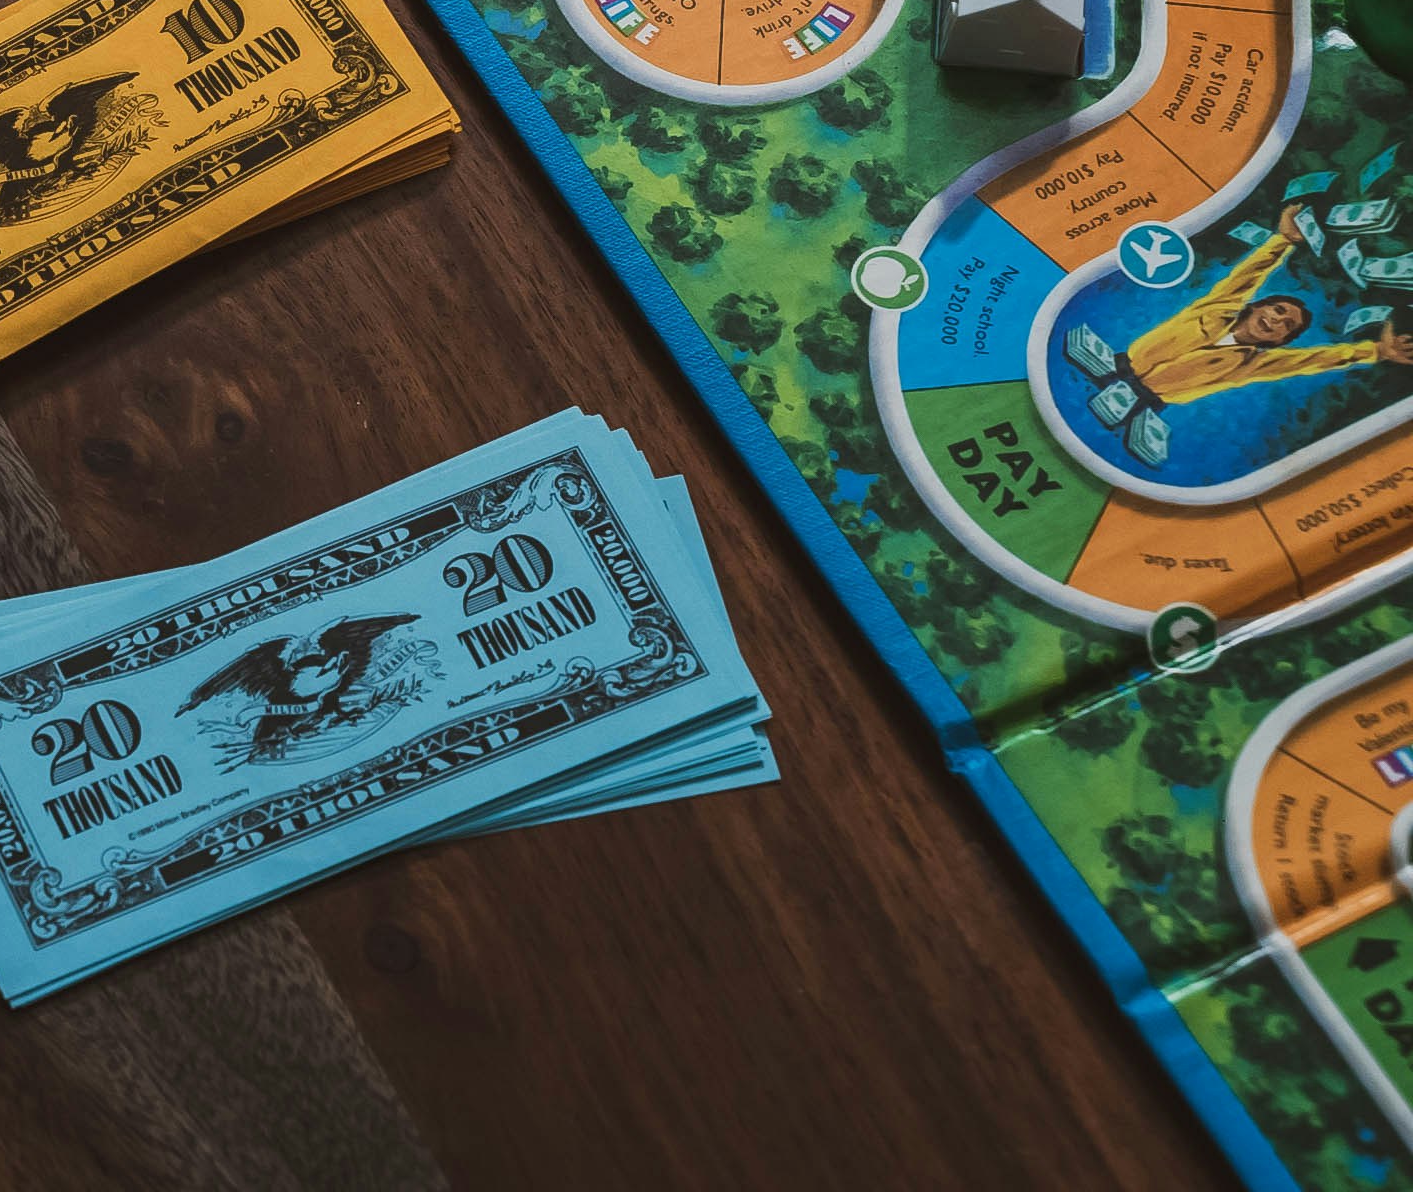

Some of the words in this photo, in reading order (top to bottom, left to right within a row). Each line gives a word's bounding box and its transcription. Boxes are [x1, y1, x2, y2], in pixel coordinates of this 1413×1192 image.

[753, 14, 793, 38] drink
[783, 6, 851, 60] LIFE
[174, 27, 301, 113] THOUSAND
[1188, 51, 1203, 69] not
[1209, 43, 1233, 67] Pay
[1246, 48, 1264, 75] Car
[107, 96, 141, 132] BRADLEY
[1159, 74, 1199, 122] insured.
[5, 168, 46, 180] MILTON
[1096, 149, 1125, 168] Pay
[1066, 180, 1127, 215] country.
[1115, 191, 1158, 216] Move
[21, 162, 242, 289] THOUSAND
[1065, 213, 1112, 240] across
[958, 256, 987, 281] Pay
[989, 264, 1021, 304] Night
[947, 437, 1030, 518] DAY
[983, 421, 1063, 498] PAY
[106, 626, 160, 657] 20
[165, 527, 410, 630] THOUSAND
[443, 534, 553, 617] 20
[457, 586, 596, 669] THOUSAND
[379, 642, 418, 679] BRADLEY
[264, 704, 309, 715] MILTON
[31, 699, 142, 786] 20
[43, 754, 183, 840] THOUSAND
[210, 831, 265, 864] 20
[271, 727, 520, 837] THOUSAND
